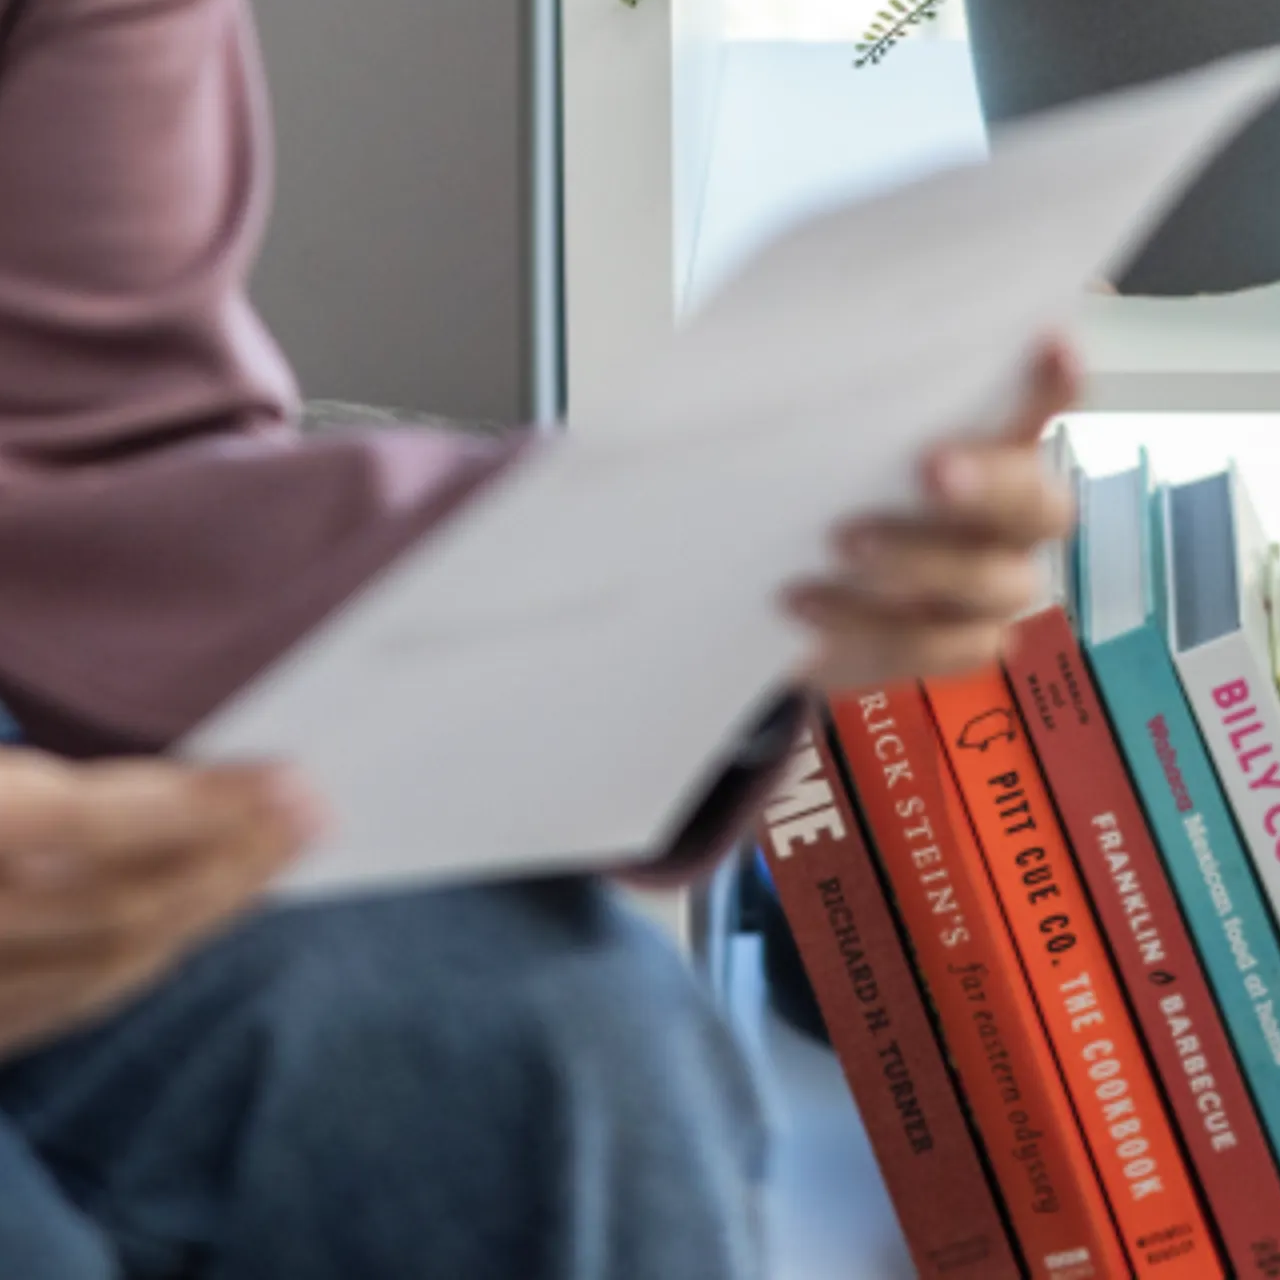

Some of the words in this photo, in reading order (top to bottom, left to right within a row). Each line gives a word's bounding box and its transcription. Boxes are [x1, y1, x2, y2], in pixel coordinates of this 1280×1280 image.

[764, 725, 847, 860] ME
[858, 691, 913, 788] RICK
[895, 796, 969, 947] STEIN'S
[988, 771, 1037, 835] PITT
[1015, 846, 1061, 904] CUE
[1039, 914, 1077, 966] CO.
[1183, 811, 1234, 917] Mexican
[1223, 916, 1258, 971] food
[1243, 972, 1269, 999] at
[818, 876, 878, 1004] RICHARD
[878, 1041, 934, 1156] TURNER
[1060, 971, 1104, 1032] THE
[1091, 811, 1165, 964] FRANKLIN
[1159, 993, 1237, 1151] BARBECUE
[947, 961, 988, 1002] far
[973, 1010, 1020, 1103] eastern
[1007, 1110, 1059, 1214] odyssey
[1081, 1039, 1164, 1201] COOKBOOK
